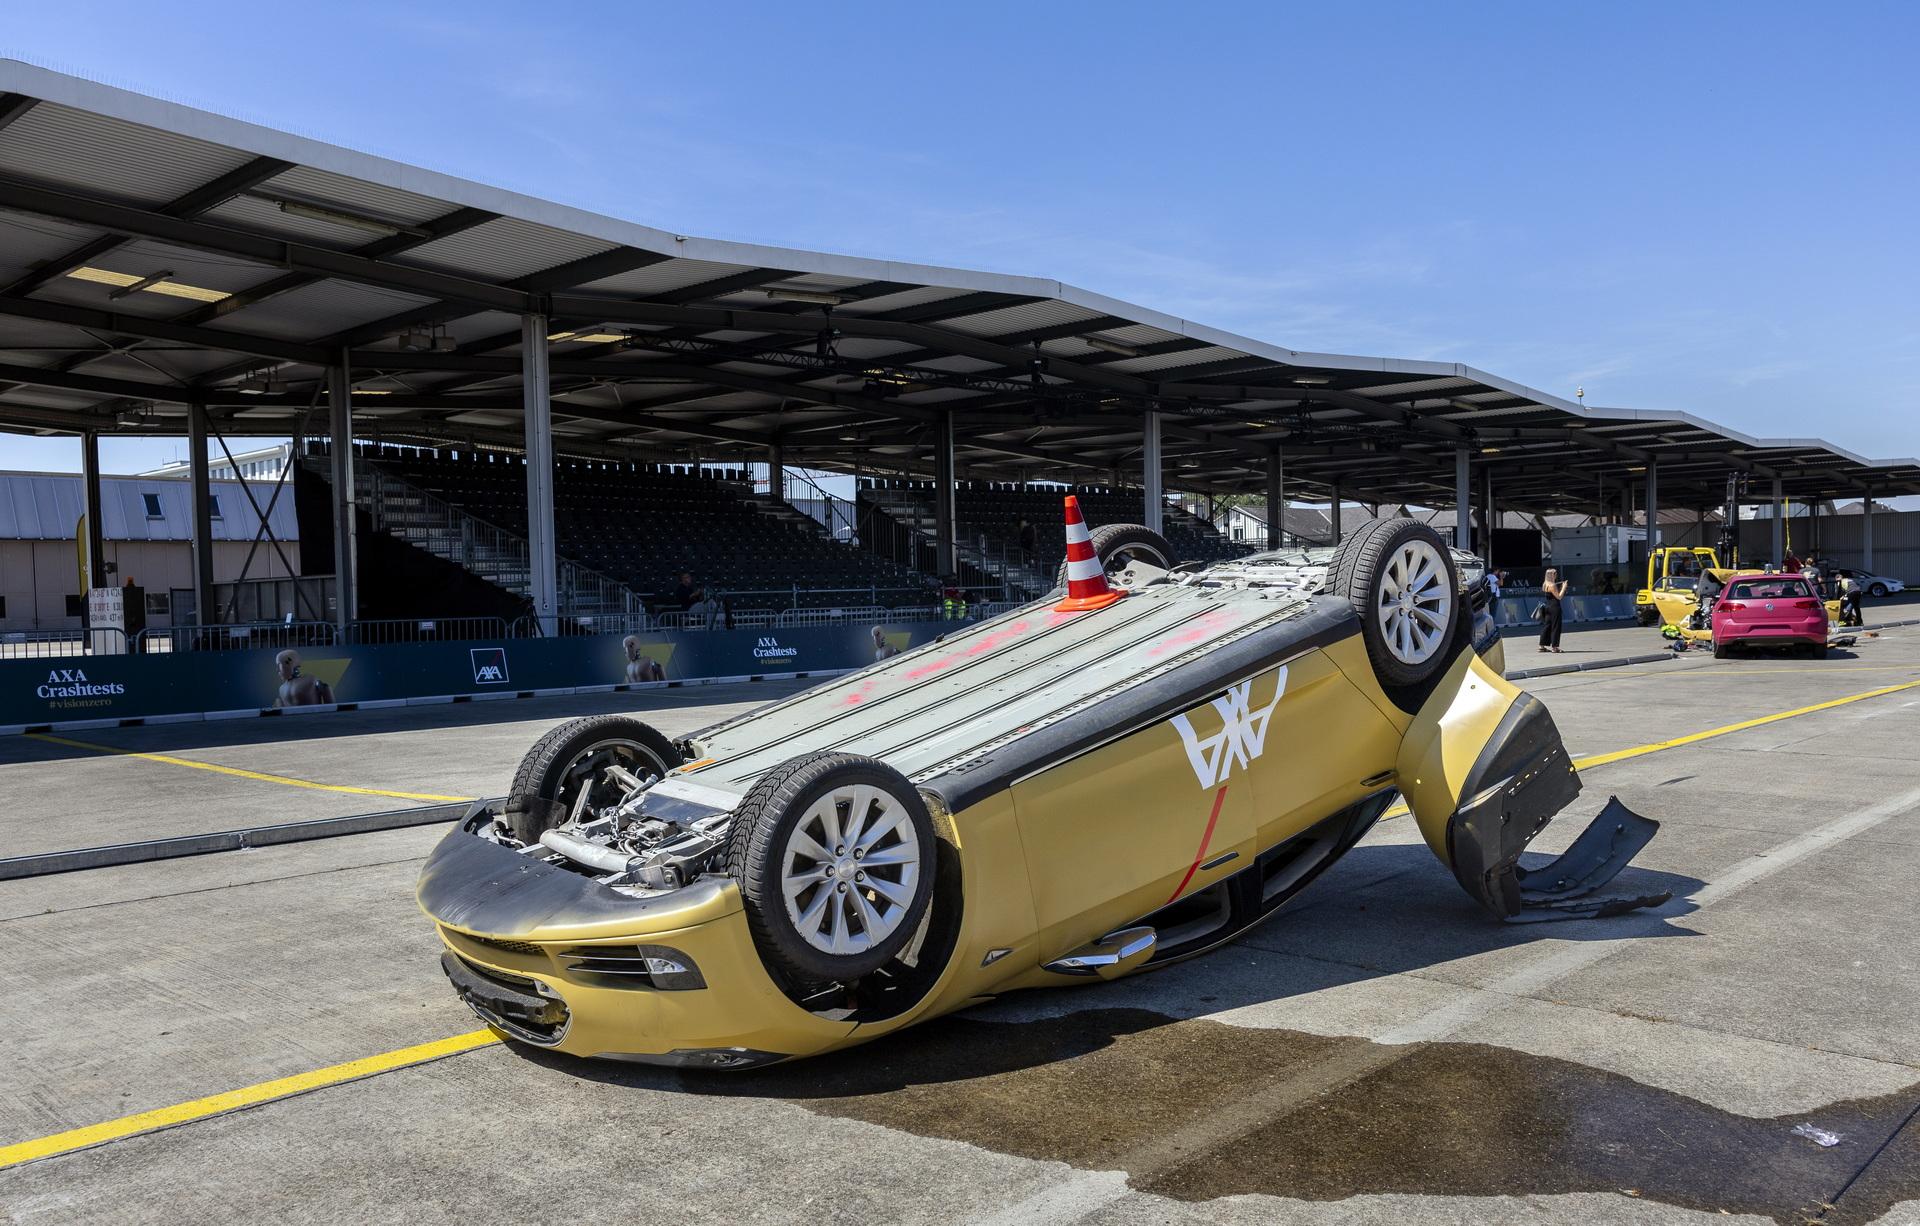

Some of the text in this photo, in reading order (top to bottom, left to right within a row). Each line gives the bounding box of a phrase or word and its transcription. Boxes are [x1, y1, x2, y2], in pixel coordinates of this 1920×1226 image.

[758, 637, 778, 647] AXA
[753, 647, 798, 658] Crashtests
[48, 669, 87, 683] AXA
[476, 665, 503, 681] AXA
[37, 683, 125, 698] Crashtests
[49, 699, 112, 709] #visionzero
[1169, 664, 1288, 790] AXA
